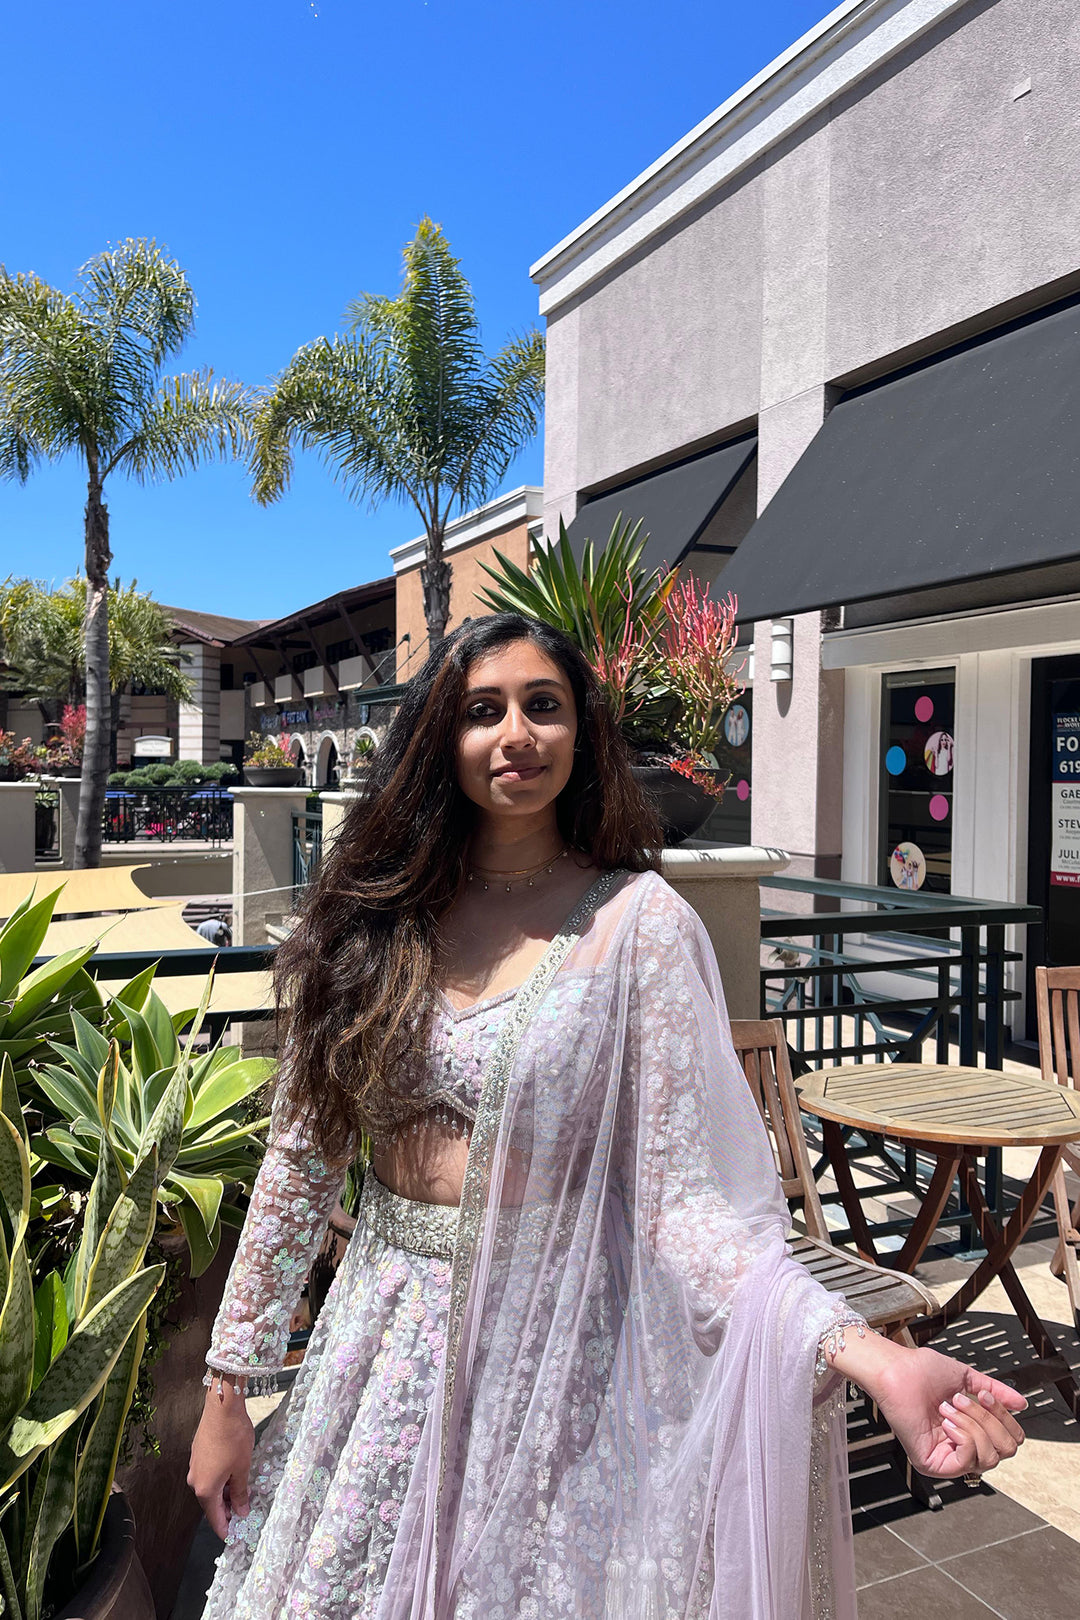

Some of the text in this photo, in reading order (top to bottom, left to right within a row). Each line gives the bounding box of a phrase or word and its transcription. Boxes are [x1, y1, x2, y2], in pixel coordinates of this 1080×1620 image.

[1056, 736, 1079, 752] FO
[1059, 760, 1080, 773] 619
[1058, 849, 1079, 859] JULI
